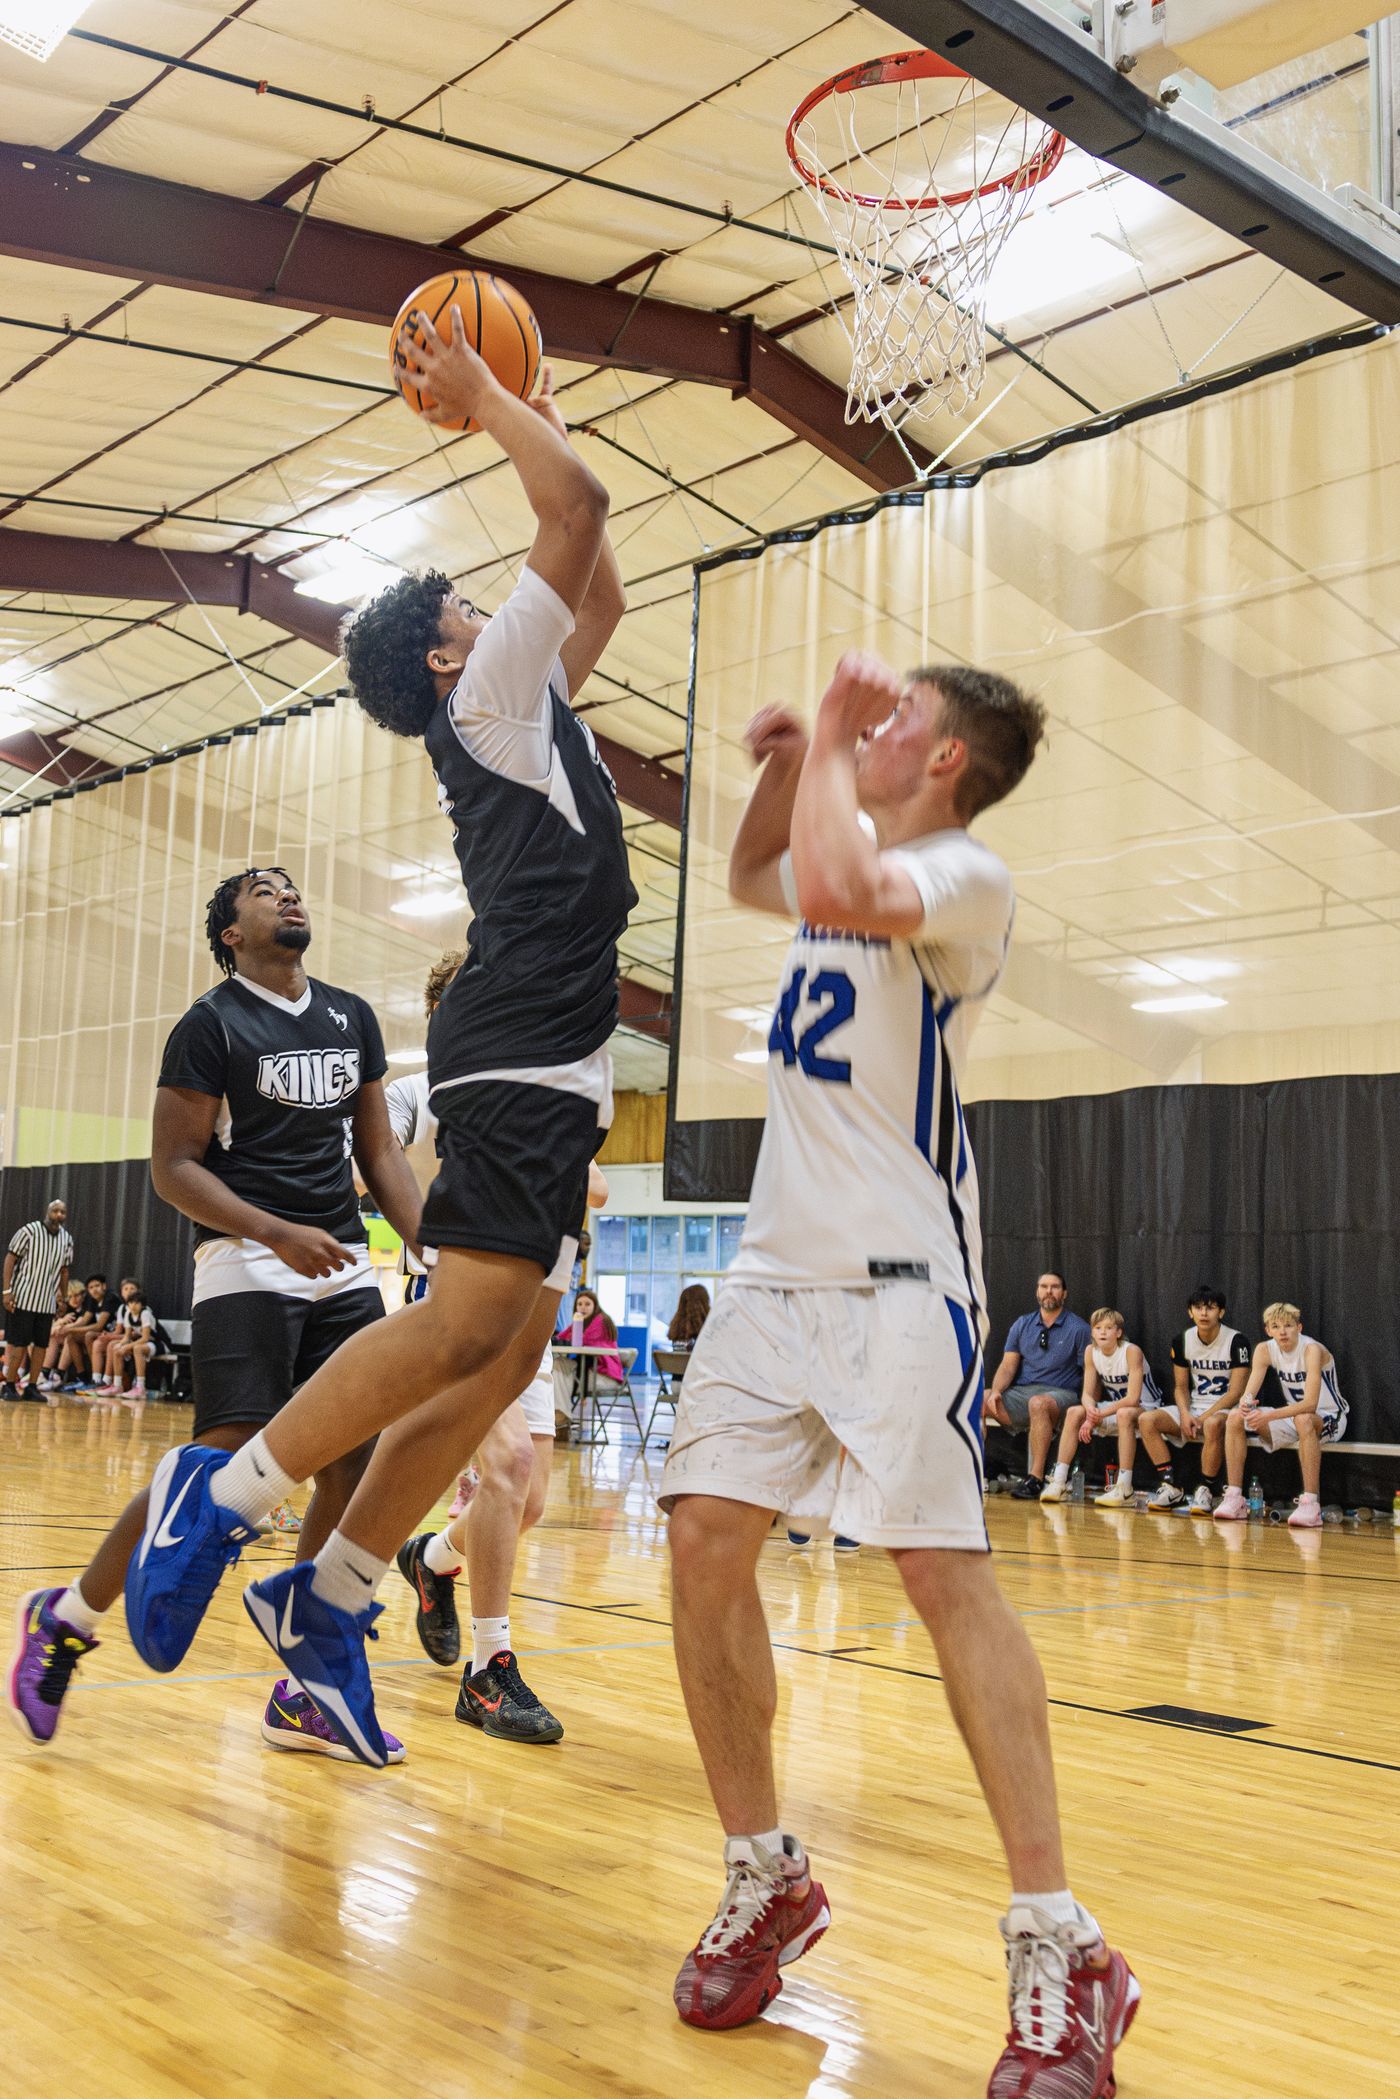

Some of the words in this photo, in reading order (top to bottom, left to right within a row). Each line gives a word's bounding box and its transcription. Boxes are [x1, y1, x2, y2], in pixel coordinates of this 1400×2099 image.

[768, 967, 856, 1084] 42
[257, 1048, 361, 1109] KINGS
[1197, 1374, 1229, 1396] 23
